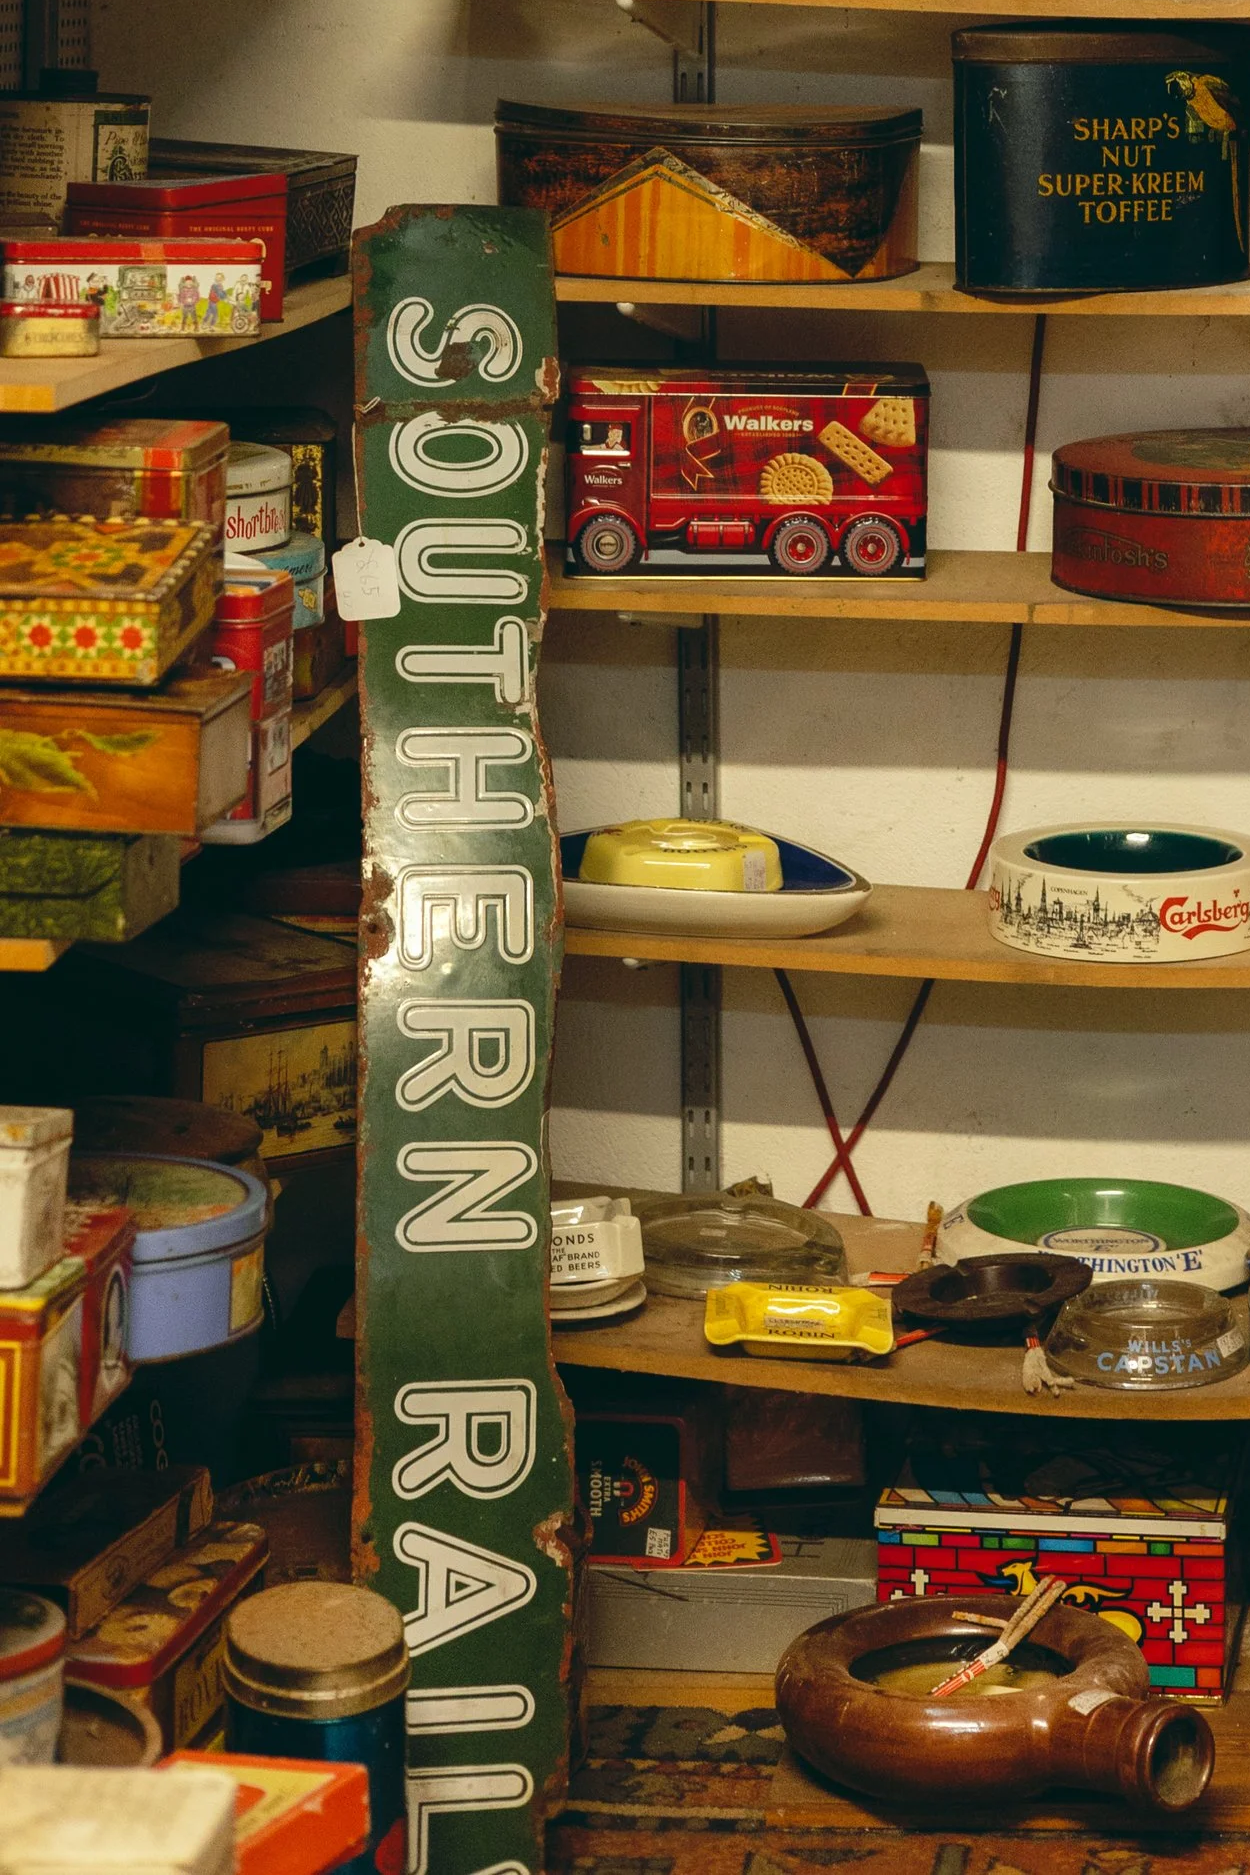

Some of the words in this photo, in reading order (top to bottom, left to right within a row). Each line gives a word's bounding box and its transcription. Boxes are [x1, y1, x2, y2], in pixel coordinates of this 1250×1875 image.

[1073, 112, 1181, 142] SHARP'S
[1101, 144, 1156, 168] NUT
[1078, 199, 1174, 224] TOFFEE
[723, 415, 815, 432] Walkers
[583, 474, 624, 486] Walkers
[385, 295, 541, 1253] SOUTHERN
[1049, 886, 1088, 897] COPENHAGEN
[1159, 895, 1250, 938] Carlsberg
[1050, 1236, 1150, 1246] WORTHINGTON
[566, 1251, 601, 1261] BRAND
[568, 1260, 601, 1271] BEERS
[767, 1283, 835, 1295] ROBIN
[767, 1328, 836, 1340] ROBIN
[1127, 1338, 1193, 1356] WILLS'S
[1096, 1348, 1223, 1375] CAPSTAN
[589, 1460, 603, 1518] SMOOTH
[603, 1475, 612, 1503] EXTRA
[621, 1484, 655, 1524] SMITH'S
[391, 1378, 539, 1875] RAIL
